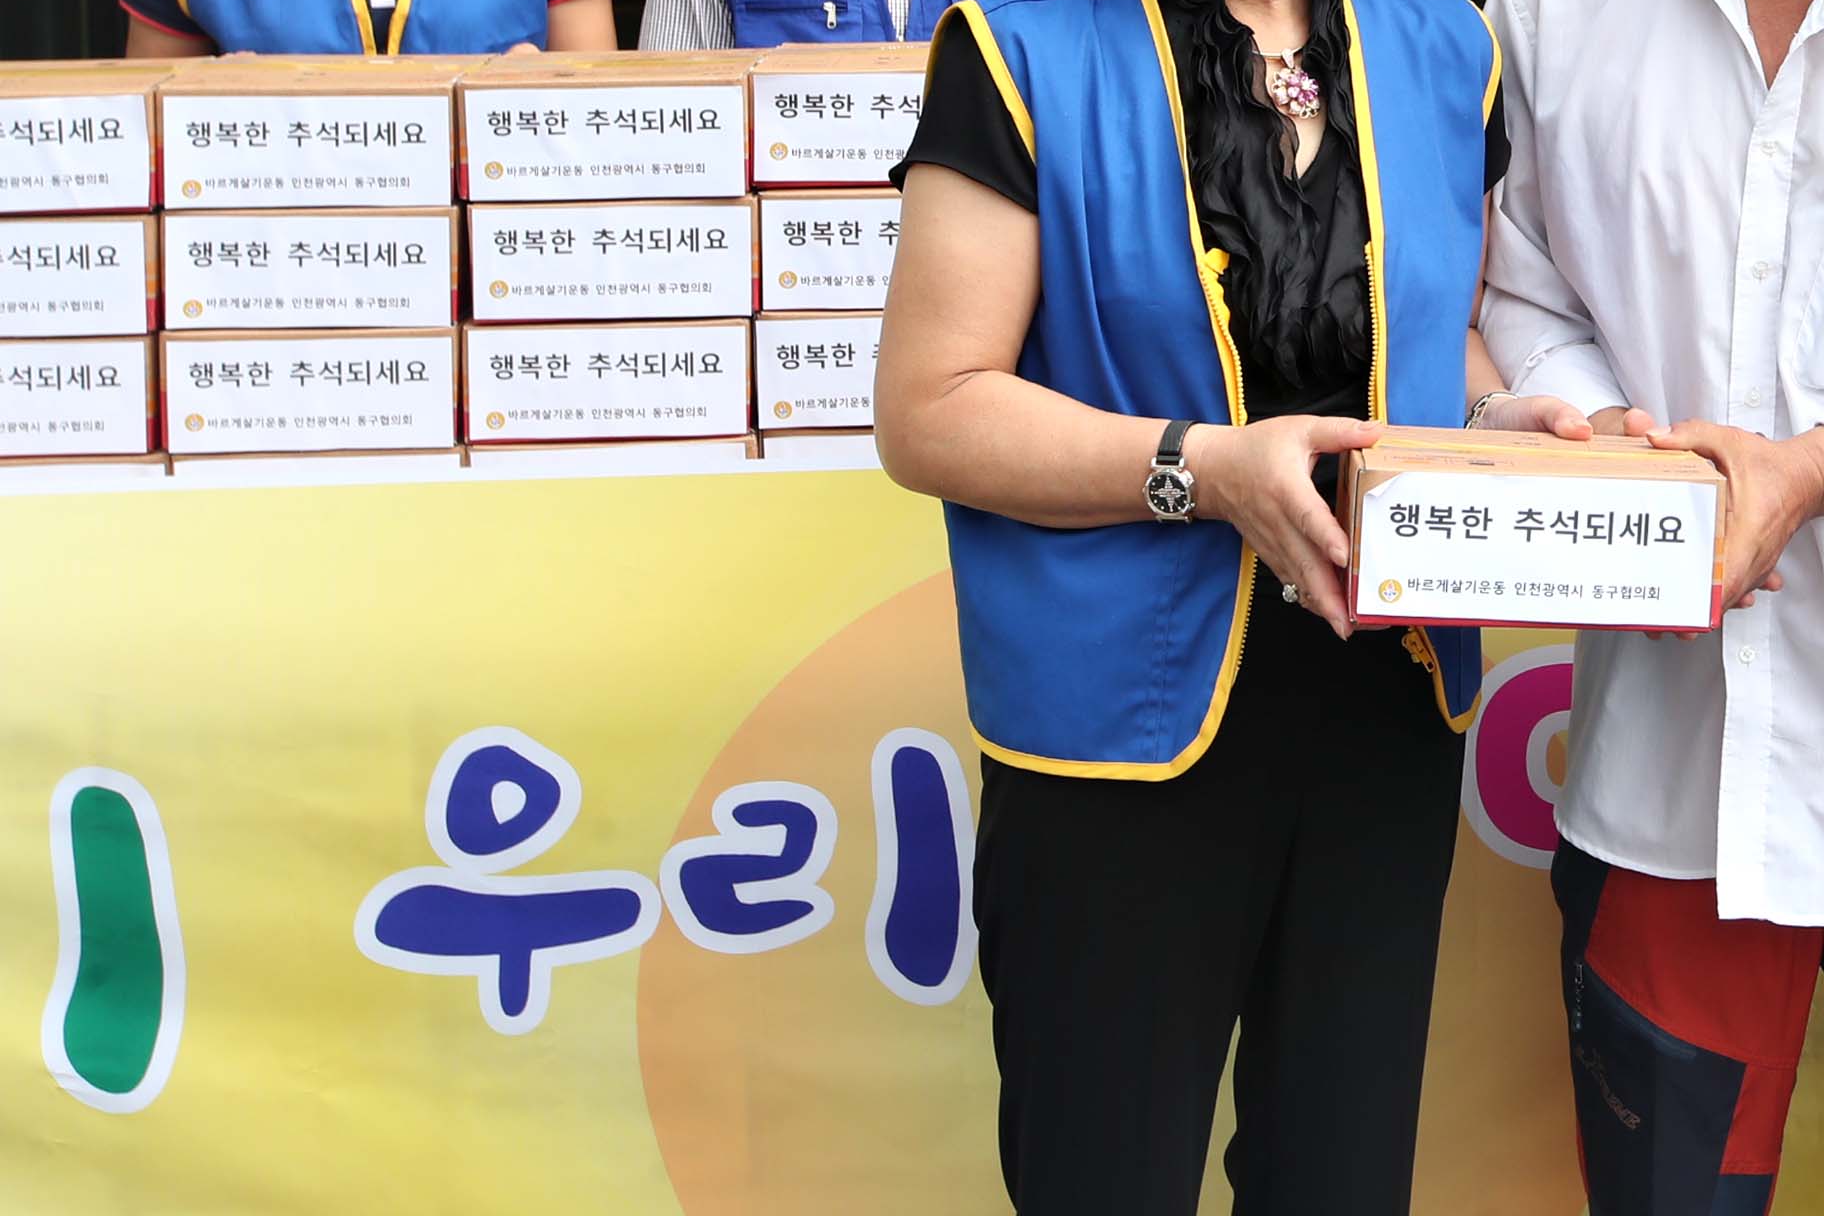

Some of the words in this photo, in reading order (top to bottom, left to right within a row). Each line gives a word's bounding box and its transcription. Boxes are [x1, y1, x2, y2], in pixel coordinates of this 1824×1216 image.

[774, 92, 855, 120] 행복한
[487, 109, 569, 137] 행복한
[585, 107, 722, 136] 추석되세요
[186, 120, 271, 148] 행복한
[287, 120, 427, 148] 추석되세요
[791, 148, 867, 160] 바르게살기운동
[506, 165, 583, 177] 바르게살기운동
[590, 164, 645, 176] 인천광역시
[651, 162, 706, 175] 동구협의회
[50, 173, 109, 187] 동구협의회
[205, 177, 284, 189] 바르게살기운동
[291, 177, 348, 189] 인천광역시
[355, 176, 410, 188] 동구협의회
[493, 228, 576, 256] 행복한
[591, 226, 729, 255] 추석되세요
[782, 219, 863, 247] 행복한
[188, 240, 271, 268] 행복한
[287, 241, 427, 268] 추석되세요
[511, 284, 589, 296] 바르게살기운동
[595, 283, 651, 296] 인천광역시
[657, 282, 712, 294] 동구협의회
[800, 275, 876, 287] 바르게살기운동
[47, 300, 105, 313] 동구협의회
[206, 297, 284, 309] 바르게살기운동
[291, 297, 347, 309] 인천광역시
[355, 297, 410, 309] 동구협의회
[489, 353, 572, 381] 행복한
[587, 351, 724, 380] 추석되세요
[775, 342, 857, 371] 행복한
[188, 361, 273, 389] 행복한
[289, 359, 430, 388] 추석되세요
[794, 396, 870, 409] 바르게살기운동
[207, 417, 286, 429] 바르게살기운동
[294, 416, 350, 427] 인천광역시
[358, 415, 413, 426] 동구협의회
[508, 409, 584, 420] 바르게살기운동
[591, 407, 646, 420] 인천광역시
[653, 406, 707, 419] 동구협의회
[48, 420, 106, 433] 동구협의회
[1389, 502, 1494, 541] 행복한
[1513, 507, 1686, 547] 추석되세요
[1407, 577, 1505, 596] 바르게살기운동
[1514, 582, 1583, 599] 인천광역시
[1592, 584, 1661, 601] 동구협의회
[372, 740, 960, 1020] 우리
